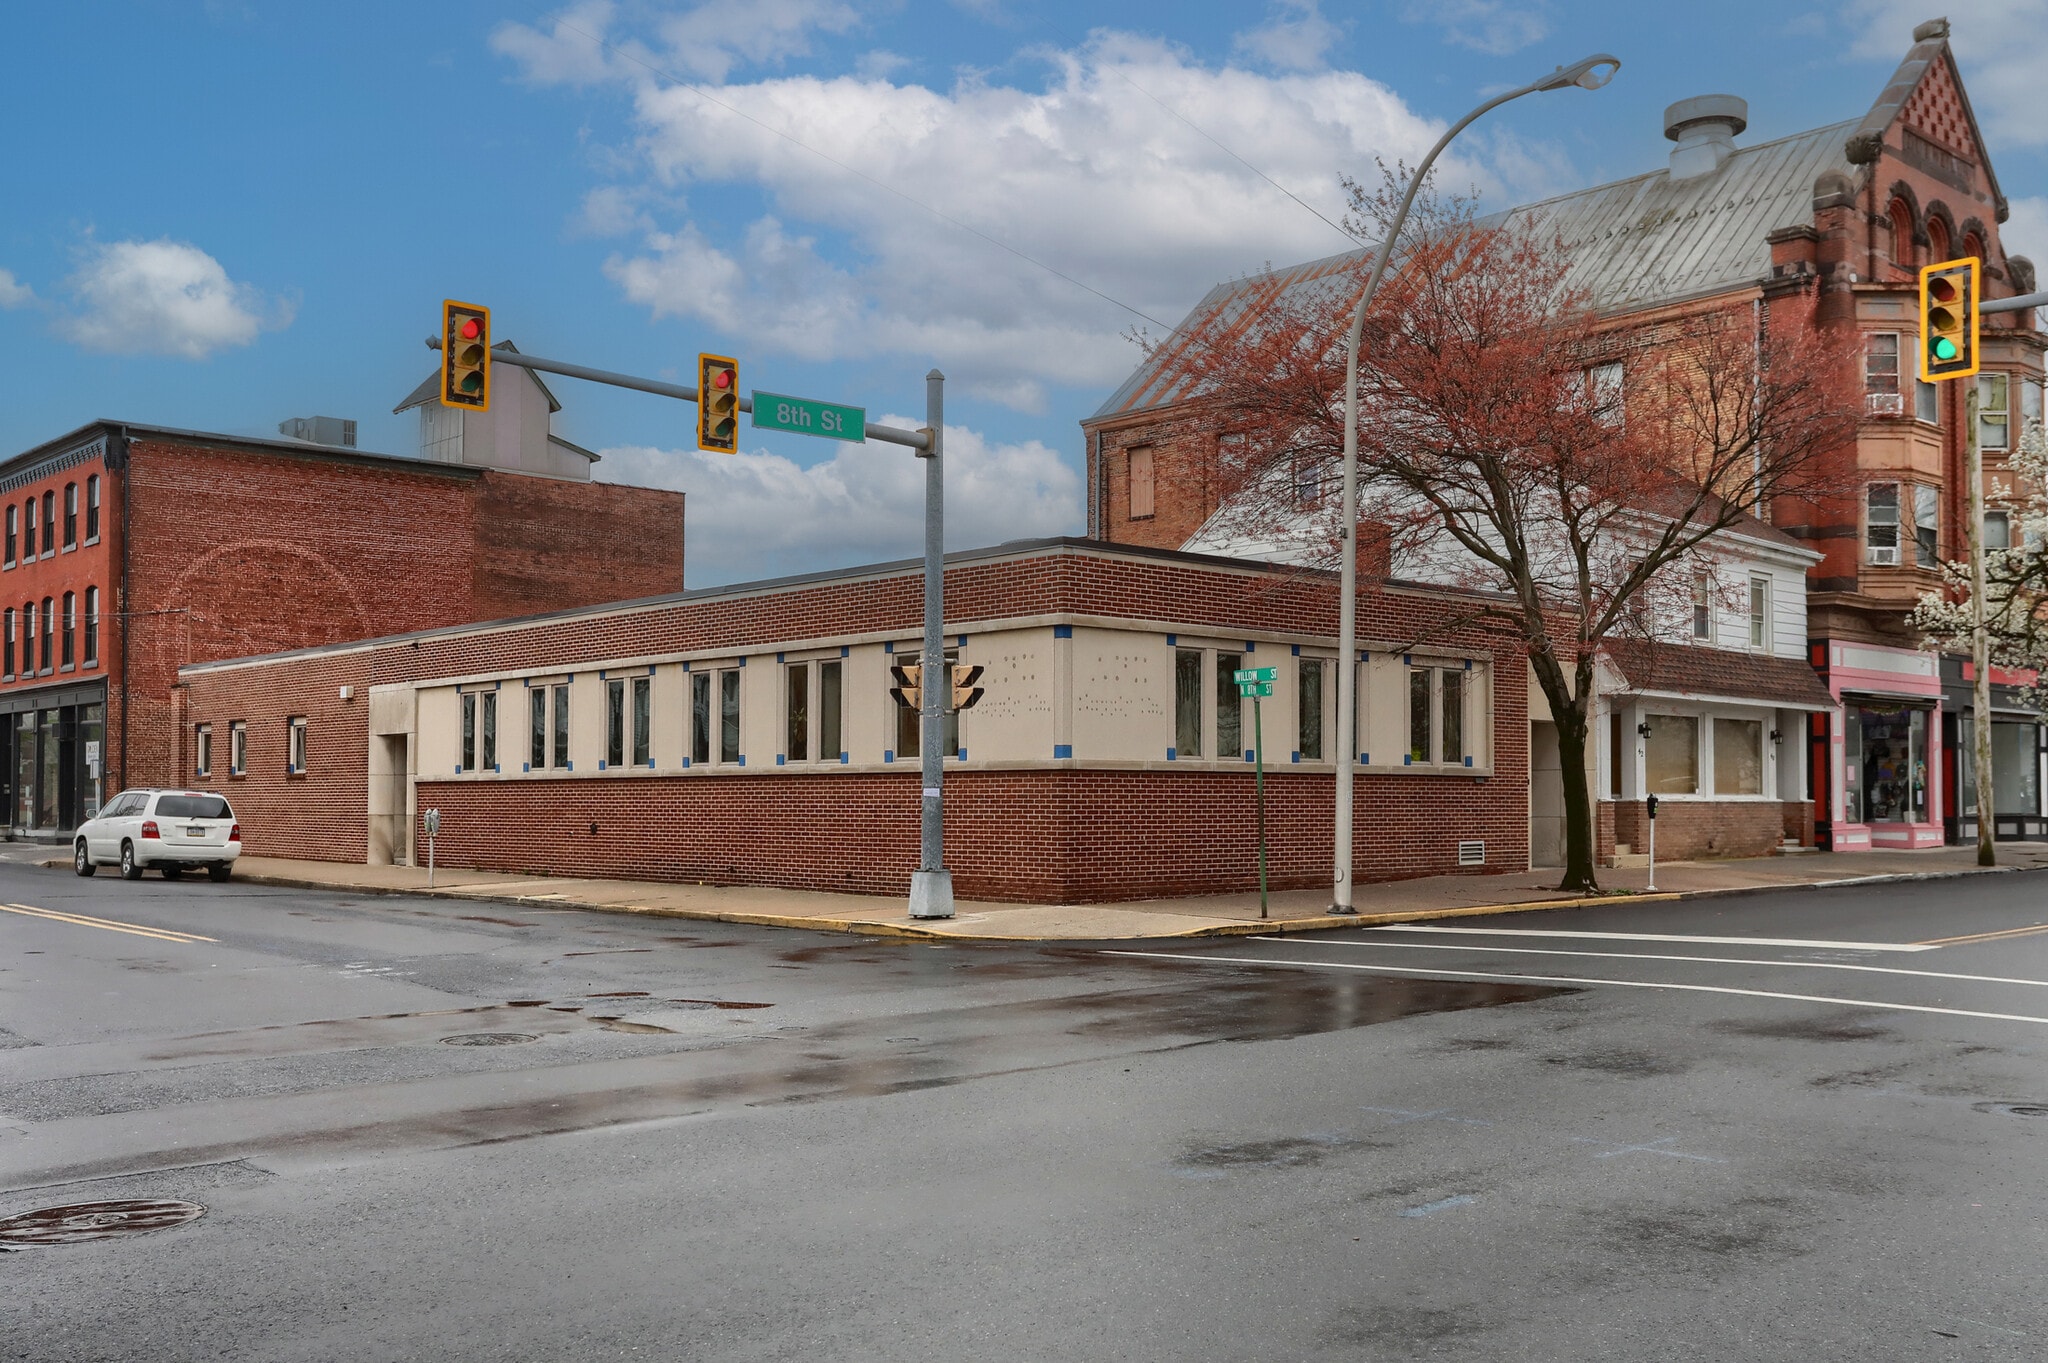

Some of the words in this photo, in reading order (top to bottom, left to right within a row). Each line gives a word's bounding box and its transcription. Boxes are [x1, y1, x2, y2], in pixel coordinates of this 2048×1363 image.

[777, 403, 811, 426] 8th
[821, 410, 842, 432] St
[1235, 670, 1257, 681] WILLOW
[1270, 668, 1277, 679] ST
[1265, 683, 1272, 694] ST
